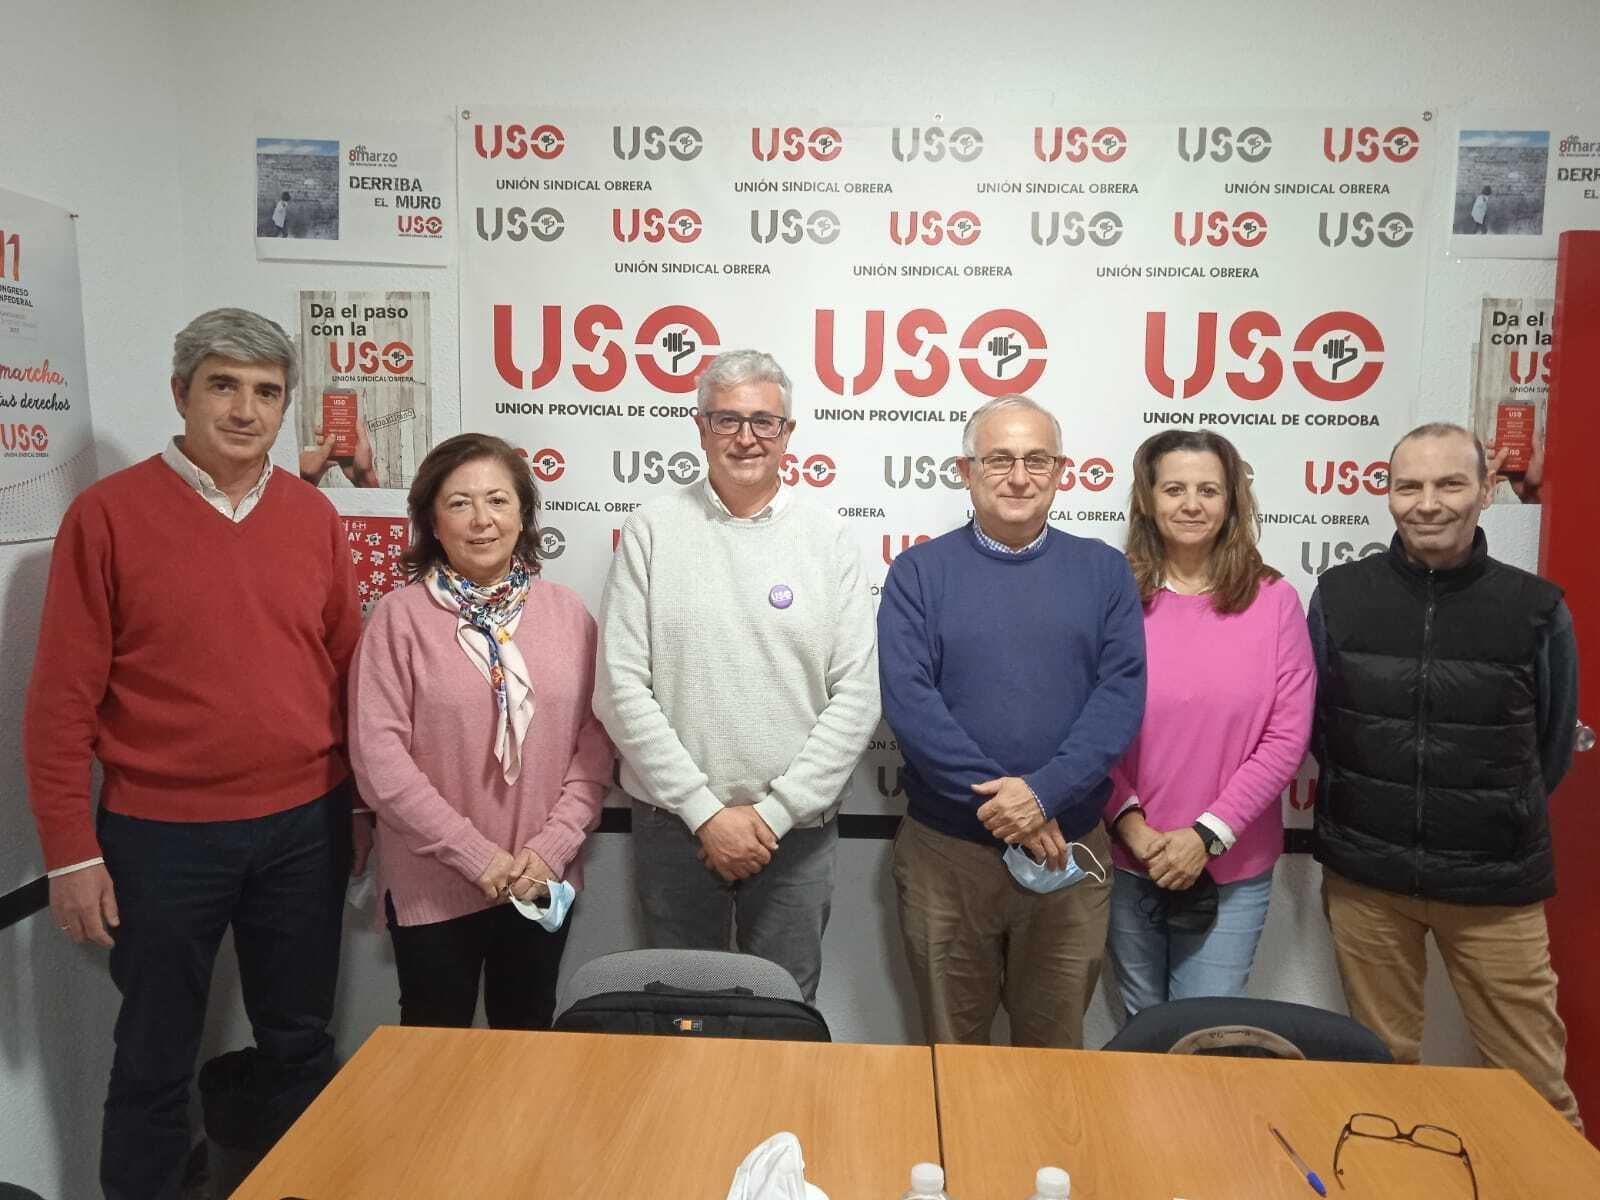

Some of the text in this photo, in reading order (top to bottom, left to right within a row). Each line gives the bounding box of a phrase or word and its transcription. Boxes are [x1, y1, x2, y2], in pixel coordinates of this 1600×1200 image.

[474, 124, 565, 160] USO
[613, 126, 703, 161] USO
[752, 127, 843, 162] USO
[892, 126, 984, 163] USO
[1034, 127, 1128, 163] USO
[1178, 127, 1272, 163] USO
[1323, 127, 1419, 164] USO
[1560, 139, 1600, 153] 8marz
[349, 176, 423, 192] DERRIBA
[496, 177, 652, 191] UNIÓN SINDICAL OBRERA
[734, 179, 893, 194] UNIÓN SINDICAL OBRERA
[1558, 168, 1600, 181] DERR
[977, 180, 1139, 194] UNIÓN SINDICAL OBRERA
[1225, 181, 1390, 195] UNIÓN SINDICAL OBRERA
[1584, 189, 1599, 199] EL
[374, 195, 441, 210] EL MURO
[398, 215, 442, 234] USO
[476, 207, 565, 242] USO
[613, 208, 703, 243] USO
[751, 209, 841, 245] USO
[890, 210, 982, 246] USO
[1031, 211, 1124, 247] USO
[1174, 211, 1268, 248] USO
[1318, 211, 1414, 248] USO
[615, 260, 771, 275] UNIÓN SINDICAL OBRERA
[853, 262, 1013, 277] UNIÓN SINDICAL OBRERA
[1096, 264, 1259, 279] UNIÓN SINDICAL OBRERA
[310, 303, 408, 321] Da el paso
[1493, 311, 1544, 326] Da el
[311, 322, 366, 337] con la
[1491, 330, 1552, 345] con la
[330, 341, 414, 374] USO
[493, 304, 720, 394] USO
[814, 308, 1048, 398] USO
[1144, 310, 1385, 402] USO
[1509, 351, 1552, 385] US
[20, 391, 70, 411] derechos
[495, 402, 699, 418] UNION PROVICIAL DE CORDO
[814, 409, 967, 422] UNION PROVICIAL DE
[1143, 411, 1380, 426] UNION PROVICIAL DE CORDOBA
[0, 424, 48, 452] USO
[613, 451, 701, 485] USO
[780, 453, 836, 488] SO
[1057, 457, 1114, 492] SO
[1305, 461, 1391, 496] USO
[545, 501, 600, 512] SINDICAL
[604, 502, 642, 512] OBRE
[838, 507, 885, 518] OBRERA
[1077, 511, 1126, 522] OBRERA
[1258, 514, 1370, 525] SINDICAL OBRERA
[1301, 541, 1390, 575] US
